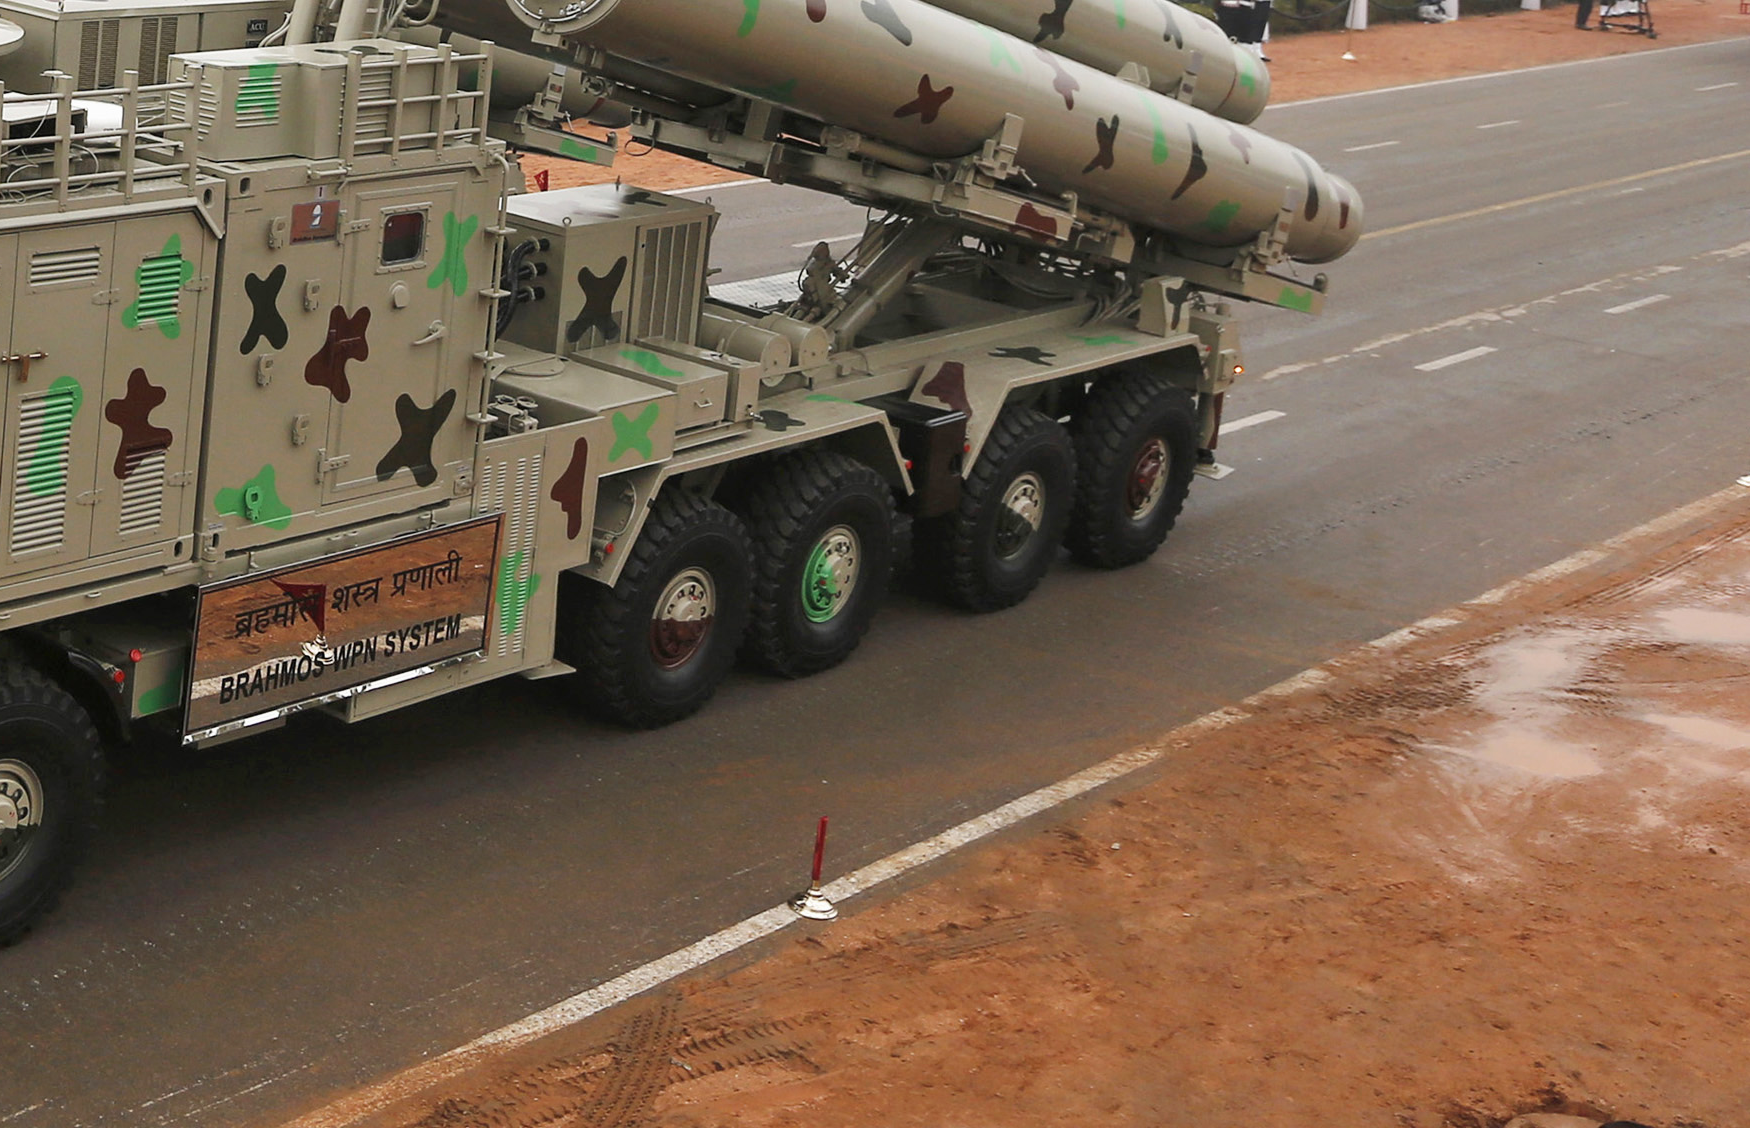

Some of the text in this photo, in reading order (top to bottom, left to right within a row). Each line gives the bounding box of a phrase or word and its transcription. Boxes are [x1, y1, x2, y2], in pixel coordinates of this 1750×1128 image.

[331, 577, 383, 613] शस्त्र
[390, 549, 463, 596] प्रणाली
[220, 613, 462, 705] BRAHMOS WPN SYSTEM
